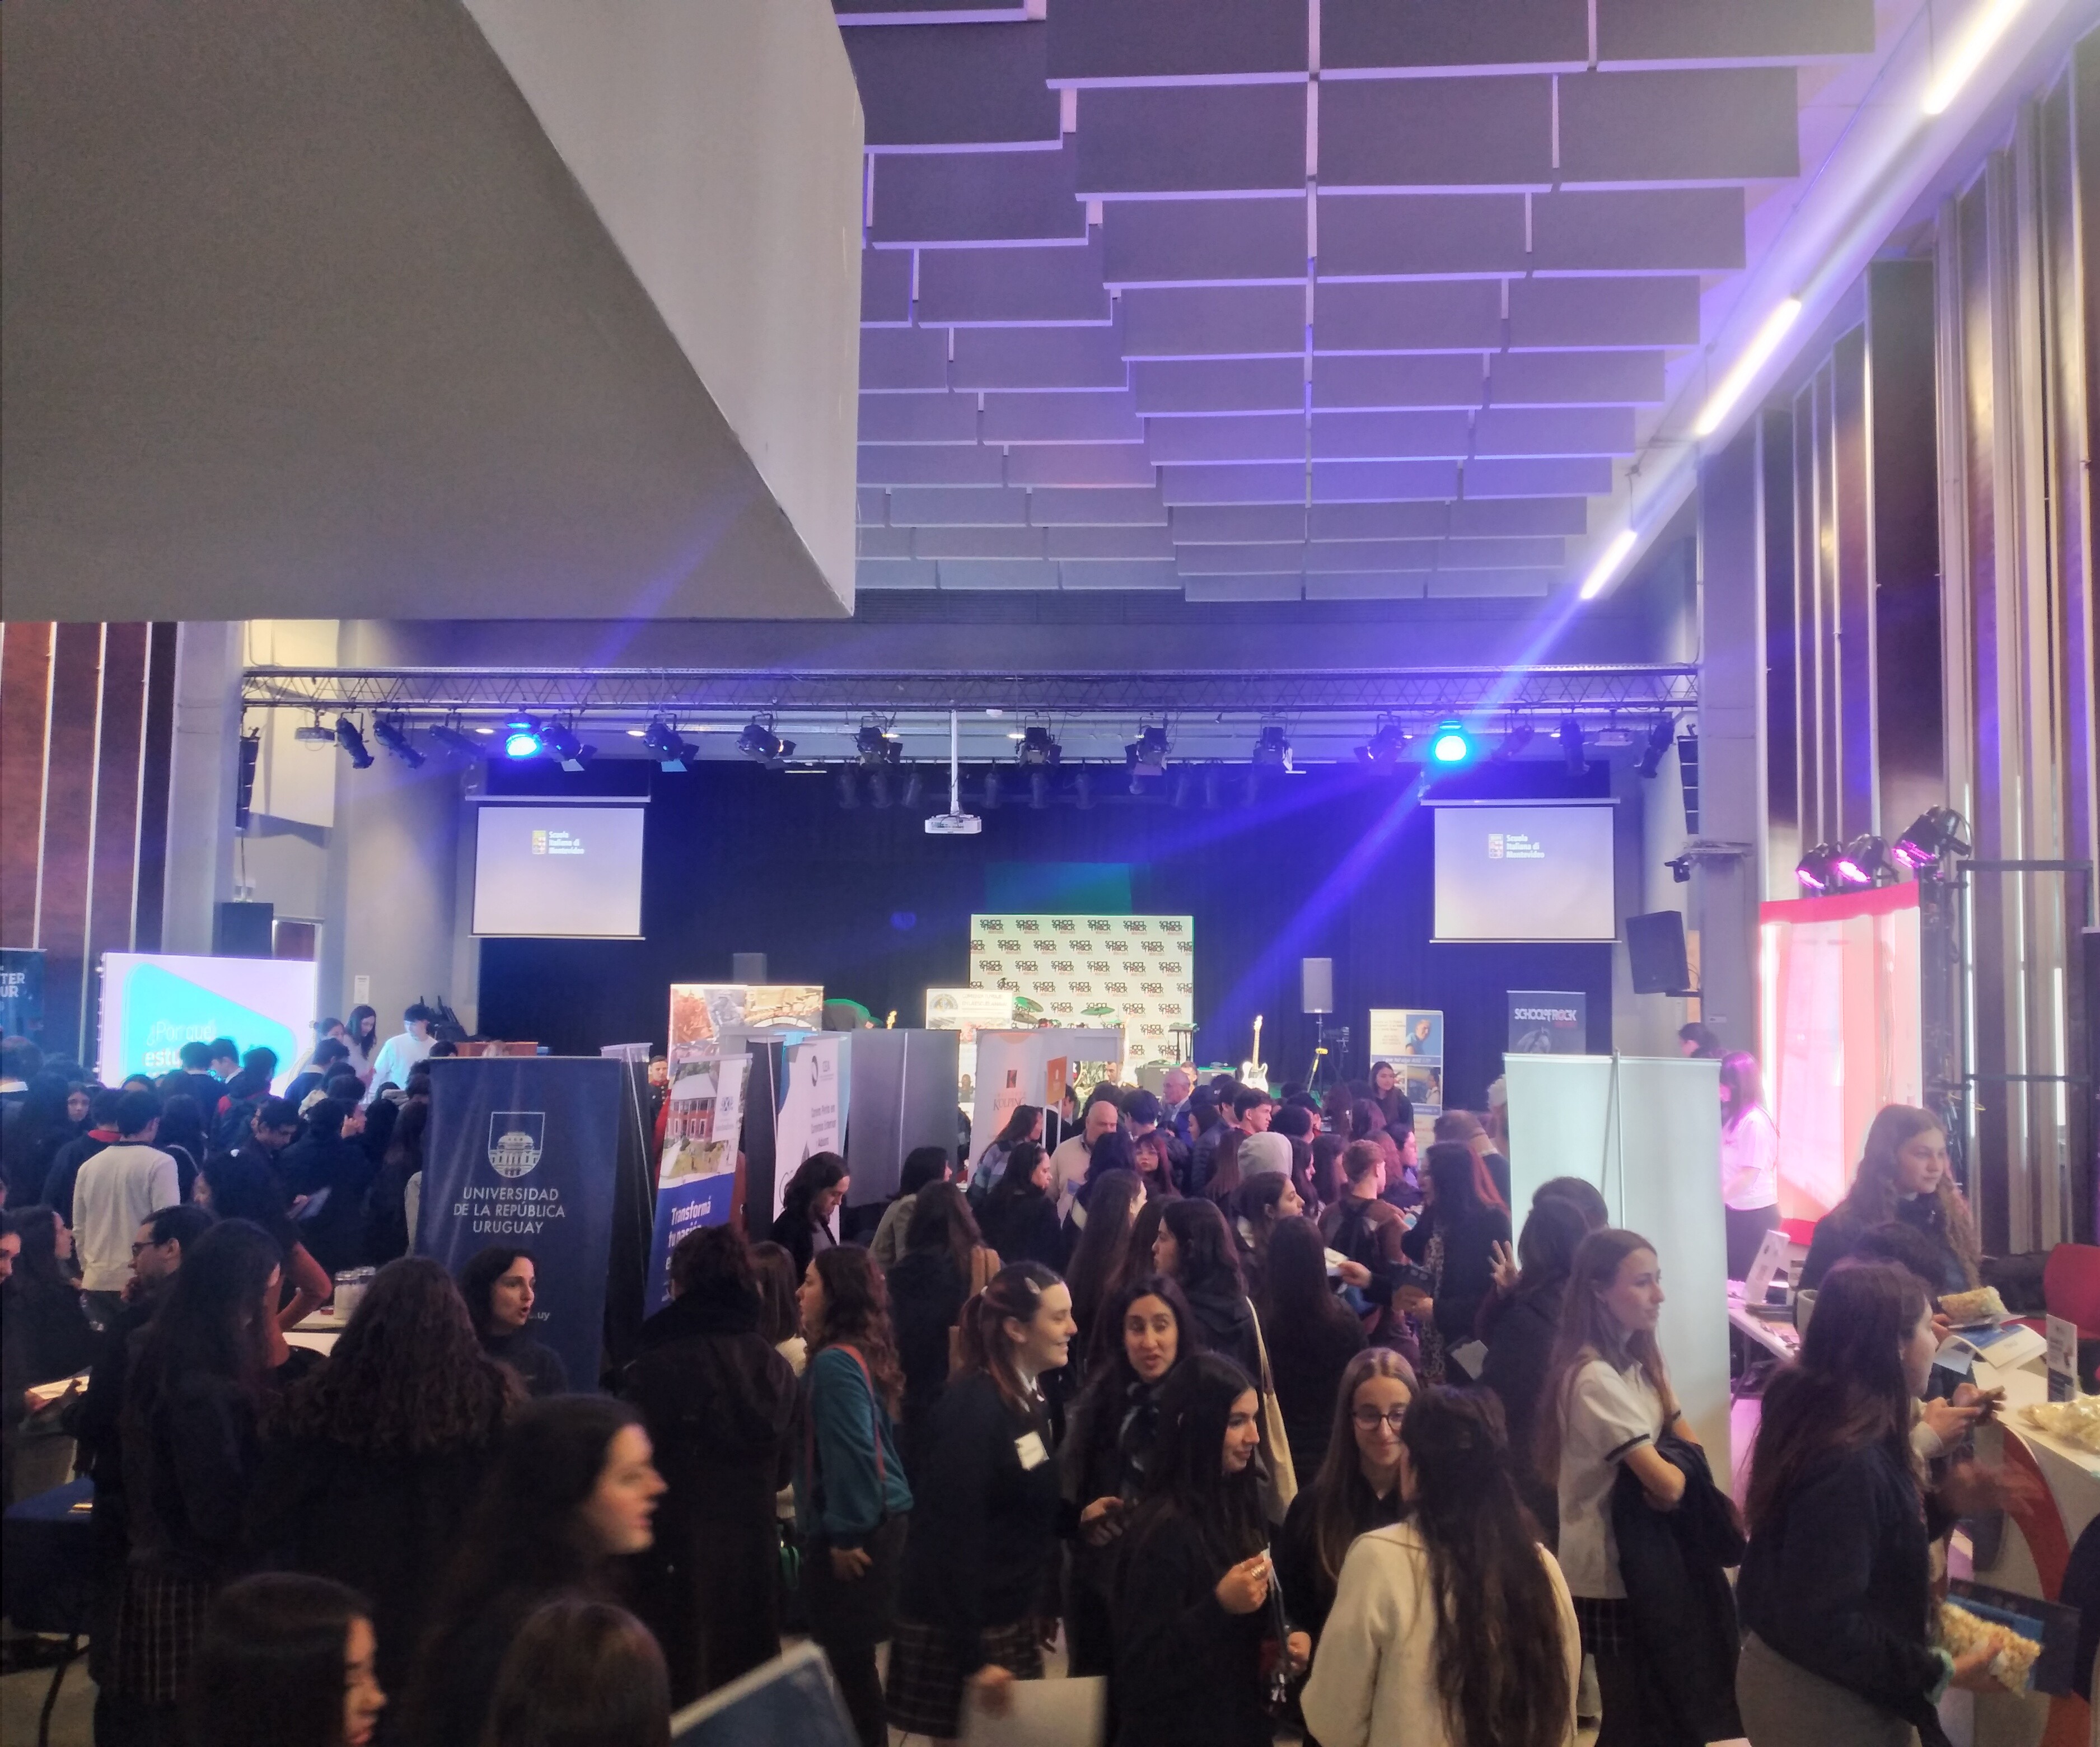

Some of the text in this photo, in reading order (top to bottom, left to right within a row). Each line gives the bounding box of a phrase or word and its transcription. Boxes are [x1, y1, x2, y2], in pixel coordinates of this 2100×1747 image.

[0, 973, 25, 984] TER
[0, 985, 18, 997] UR
[463, 1187, 559, 1201] UNIVERSIDAD
[453, 1201, 565, 1217] DE LA REPÚBLICA
[671, 1195, 712, 1226] Transformá
[473, 1220, 544, 1234] URUGUAY
